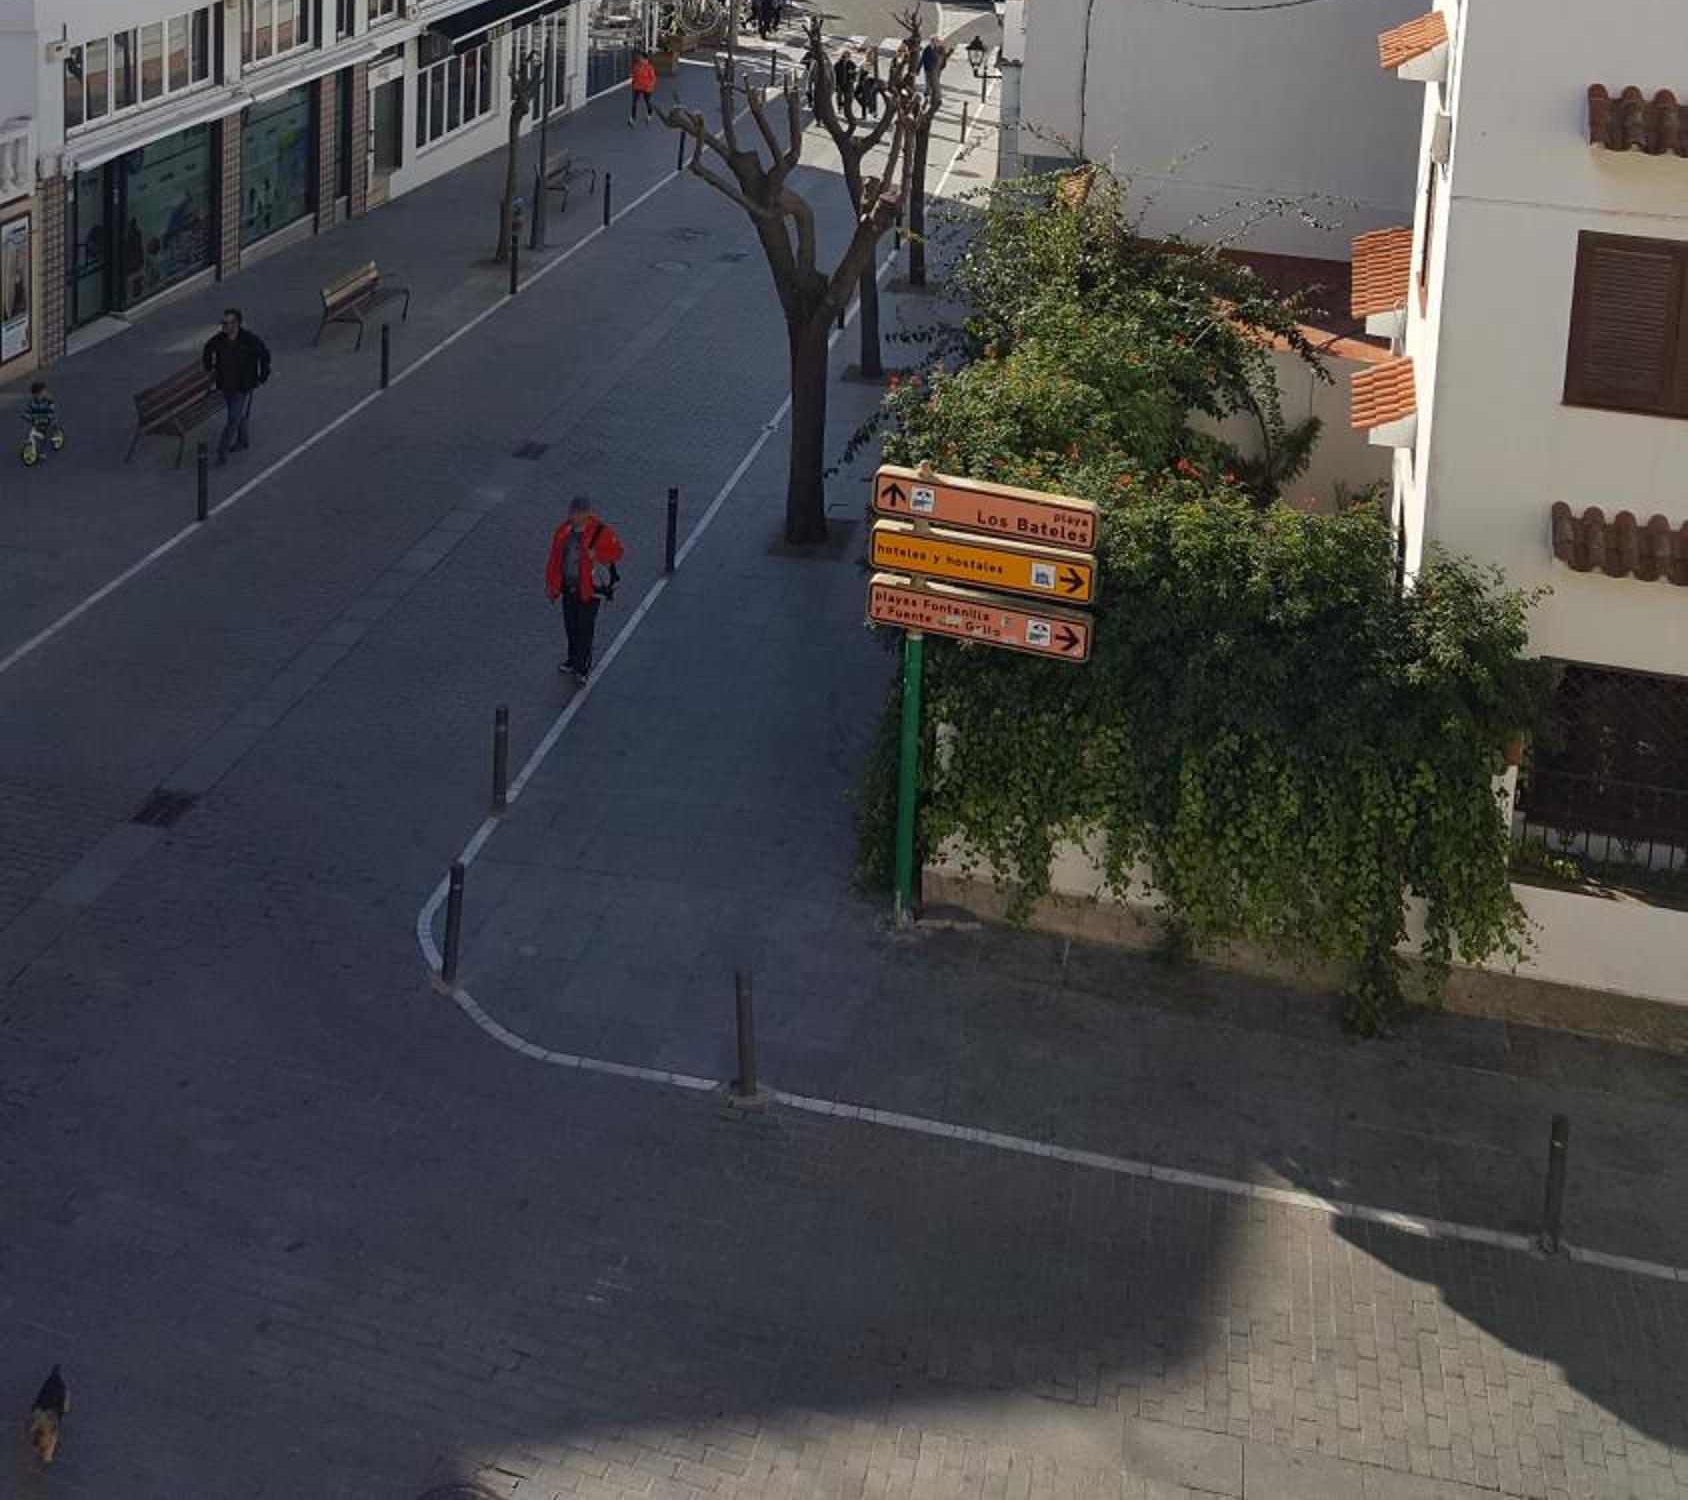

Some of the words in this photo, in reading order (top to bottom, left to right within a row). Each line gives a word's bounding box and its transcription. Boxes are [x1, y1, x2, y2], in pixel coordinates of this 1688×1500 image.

[977, 508, 1008, 528] Los
[1017, 518, 1087, 542] Bateles
[1054, 513, 1088, 527] playa
[877, 543, 927, 560] hoteles
[933, 554, 940, 565] y
[946, 556, 1003, 574] hostales
[875, 591, 917, 607] playas
[923, 599, 989, 621] Fontanilla
[875, 607, 882, 617] y
[888, 606, 932, 622] Fuente
